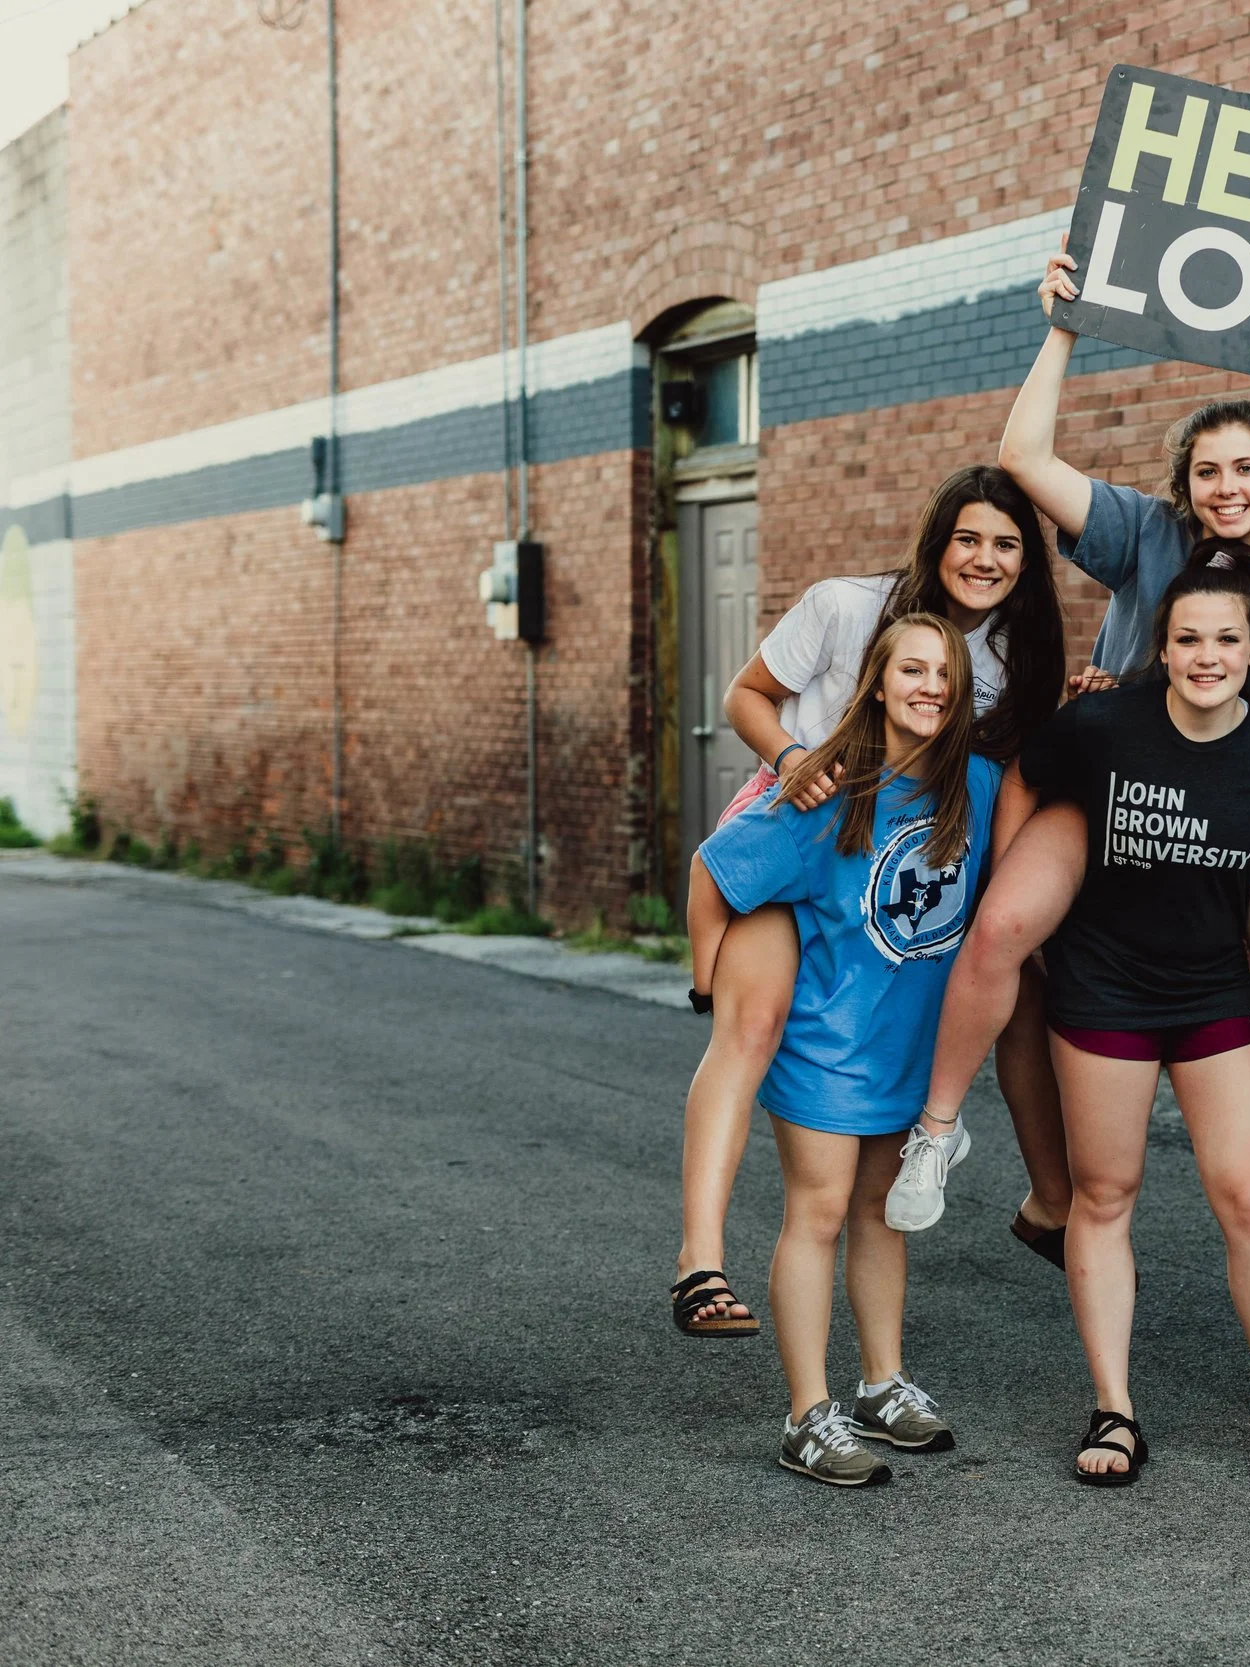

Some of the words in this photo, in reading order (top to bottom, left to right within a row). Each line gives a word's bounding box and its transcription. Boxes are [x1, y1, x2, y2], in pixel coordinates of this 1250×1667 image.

[974, 687, 996, 700] Spin
[1116, 780, 1185, 811] JOHN
[1114, 807, 1209, 841] BROWN
[882, 833, 927, 886] KINGWOOD
[1113, 855, 1127, 865] EST
[1130, 859, 1152, 869] 1919
[912, 916, 963, 944] WILDCATS
[799, 1439, 824, 1469] N
